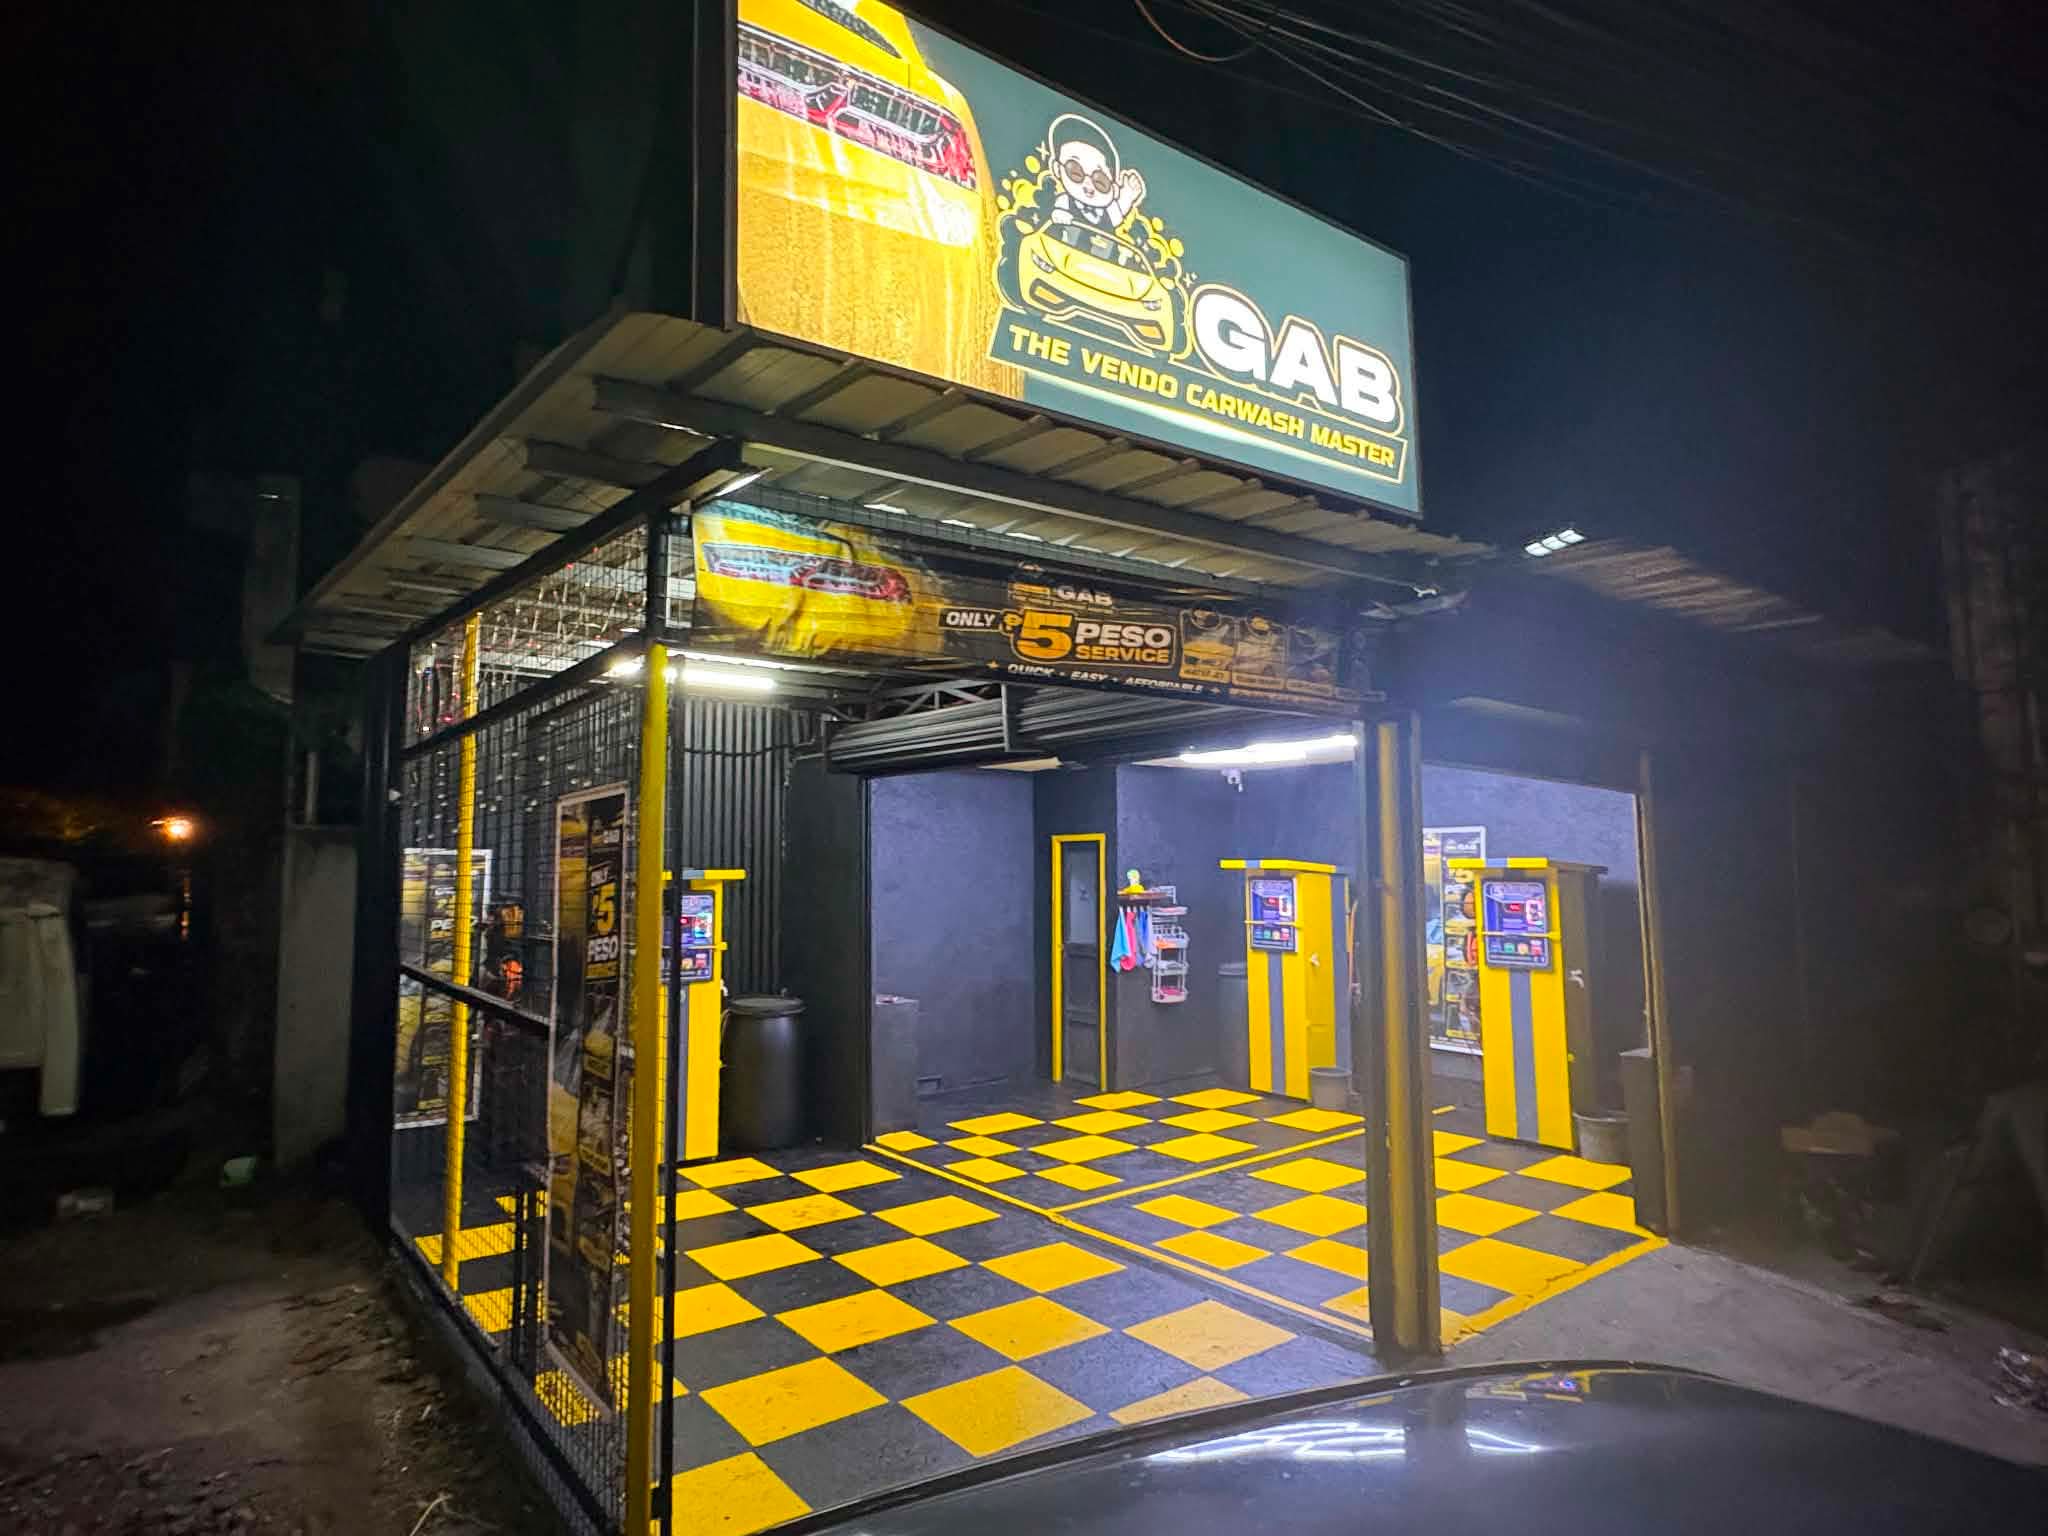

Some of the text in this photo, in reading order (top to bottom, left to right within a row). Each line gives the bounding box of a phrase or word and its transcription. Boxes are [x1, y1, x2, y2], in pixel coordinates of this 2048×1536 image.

[1192, 292, 1397, 424] GAB
[1008, 324, 1395, 468] THE VENDO CARWASH MASTER
[1056, 585, 1113, 606] GAB
[945, 610, 997, 629] ONLY
[1075, 622, 1172, 649] PESO
[1075, 645, 1169, 664] SERVICE
